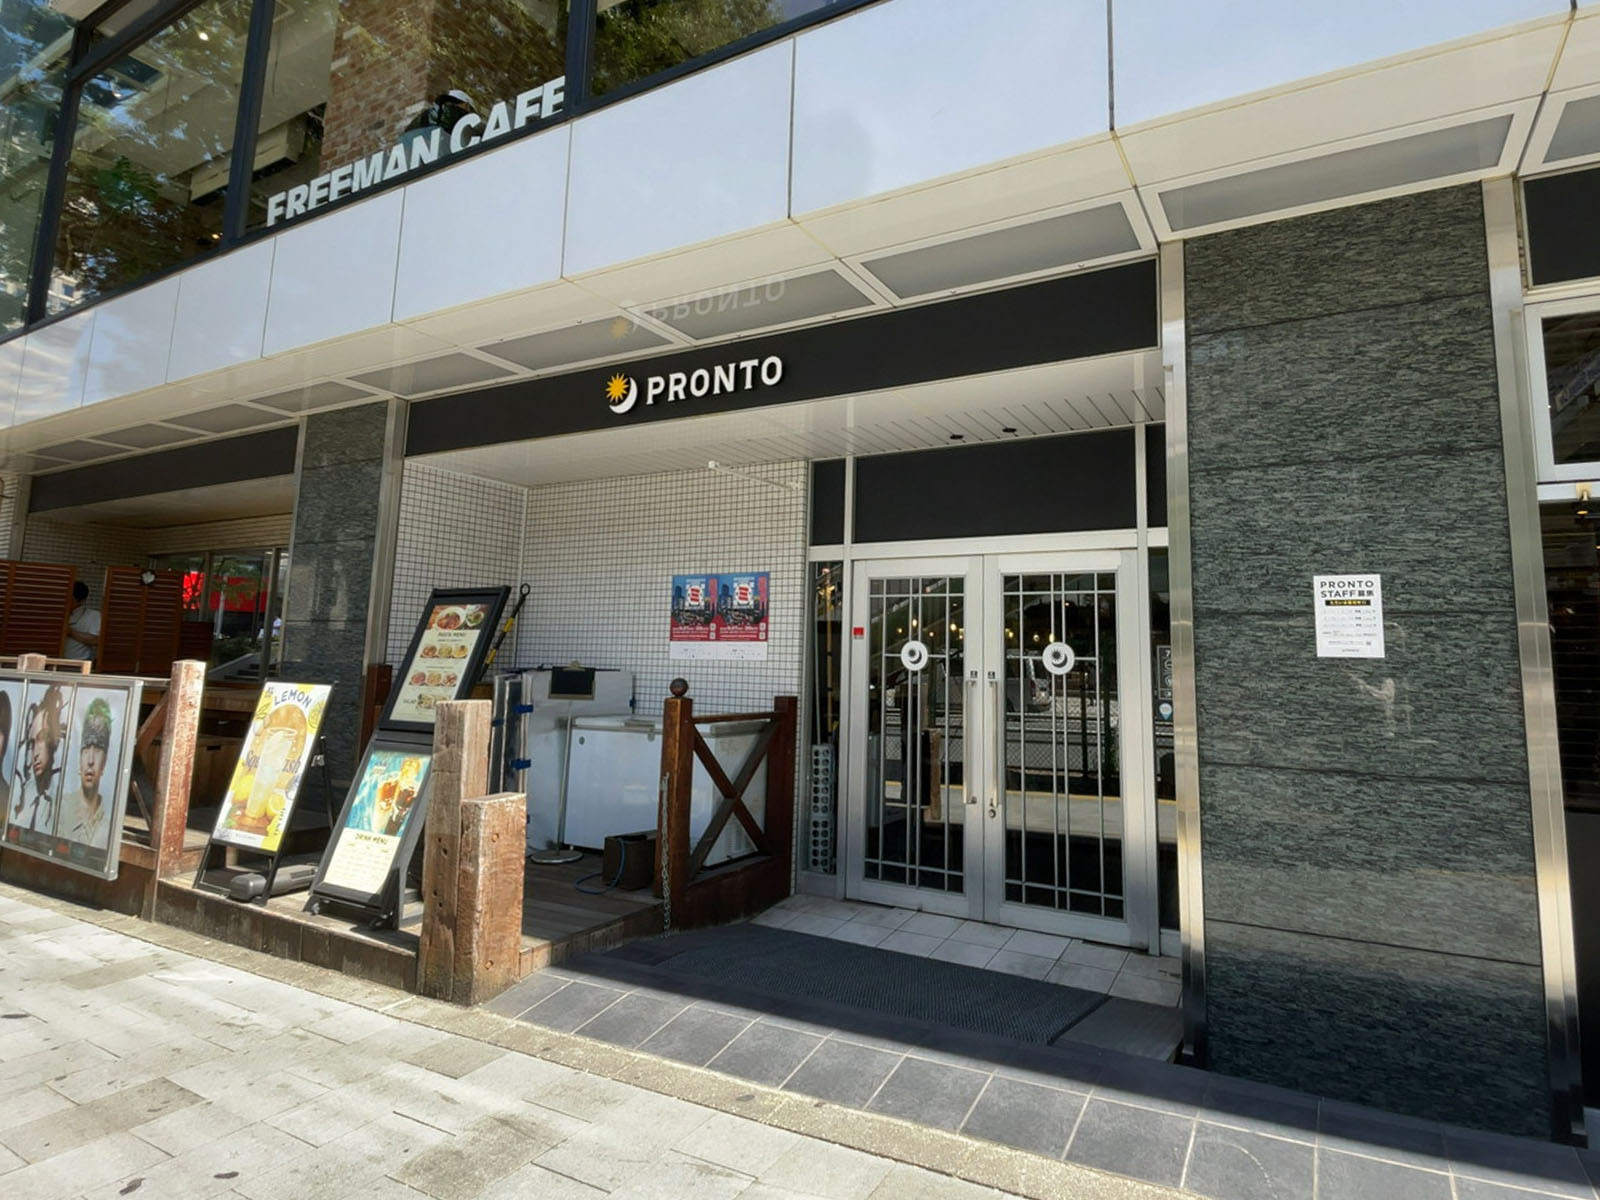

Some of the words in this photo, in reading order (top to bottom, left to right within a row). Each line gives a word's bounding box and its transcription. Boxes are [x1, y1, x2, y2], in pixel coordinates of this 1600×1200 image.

[267, 128, 441, 228] FREEMAN
[450, 75, 566, 156] CAFE
[646, 355, 783, 405] PRONTO
[1320, 580, 1374, 589] PRONTO
[1321, 590, 1356, 598] STAFF
[274, 689, 312, 708] LEMON
